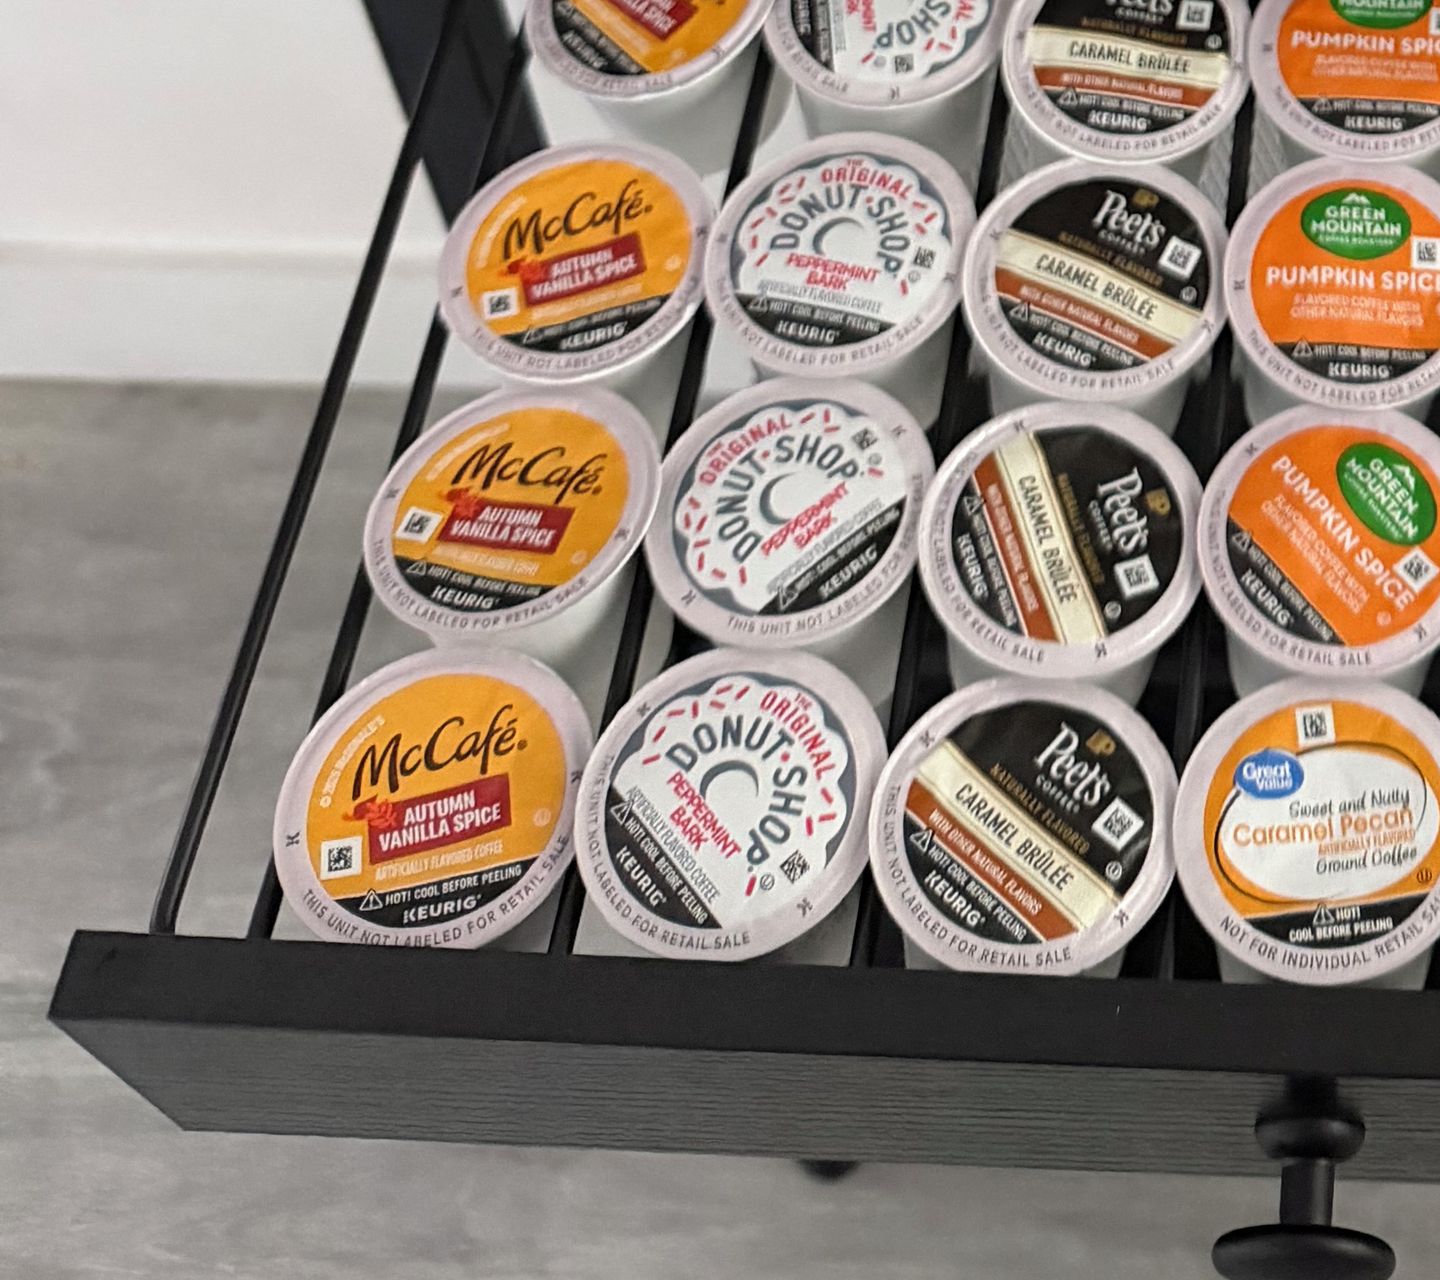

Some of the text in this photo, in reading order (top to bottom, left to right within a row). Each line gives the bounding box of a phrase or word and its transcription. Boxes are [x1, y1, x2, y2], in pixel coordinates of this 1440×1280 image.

[1070, 41, 1132, 66] CARAMEL
[1291, 31, 1395, 54] PUMPKIN
[820, 167, 913, 200] ORIGINAL
[503, 179, 644, 262] McCafé
[769, 184, 911, 274] DONUT SHOP
[1092, 190, 1166, 248] Peet's
[1311, 219, 1401, 236] MOUNTAIN
[1325, 205, 1386, 220] GREEN
[532, 253, 637, 299] VANILLA SPICE
[550, 247, 614, 277] AUTUMN
[786, 253, 881, 282] PEPPERMINT
[806, 270, 849, 290] BARK
[1036, 253, 1101, 292] CARAMEL
[1102, 285, 1158, 321] BRÛLÉE
[1266, 265, 1375, 290] PUMPKIN
[1328, 362, 1391, 378] KEURIG
[451, 442, 608, 505] McCafé
[700, 413, 792, 485] ORIGINAL
[716, 434, 861, 563] DONUT SHOP
[1097, 466, 1149, 555] Peet's
[1346, 457, 1418, 539] MOUNTAIN
[1369, 459, 1419, 514] GREEN
[450, 520, 557, 547] VANILLA SPICE
[478, 506, 543, 527] AUTUMN
[1018, 475, 1079, 604] CARAMEL BRÛLÉE
[1271, 454, 1417, 611] PUMPKIN SPICE
[957, 533, 988, 598] KEURIG
[1240, 569, 1292, 627] KEURIG
[352, 704, 518, 801] McCafé
[760, 690, 836, 780] ORIGINAL
[665, 714, 808, 865] DONUT SHOP
[1033, 721, 1112, 806] Peet's
[1242, 760, 1292, 781] Great
[1256, 774, 1293, 791] Value
[378, 802, 501, 852] VANILLA SPICE
[404, 790, 475, 825] AUTUMN
[666, 771, 743, 859] PEPPERMINT
[669, 806, 708, 853] BARK
[1233, 806, 1413, 848] Caramel Pecan
[1289, 789, 1410, 819] Sweet and Nutty
[955, 783, 1074, 892] CARAMEL BRÛLÉE
[1316, 844, 1417, 875] Ground Coffee
[303, 835, 568, 948] THIS UNIT NOT LABELED FOR RETAIL SALE
[385, 865, 522, 906] HOT! COOL BEFORE PEELING
[615, 844, 667, 907] KEURIG
[625, 816, 708, 924] HOT! COOL BEFORE PEELING
[403, 894, 480, 924] KEURIG
[924, 869, 982, 928] KEURIG
[966, 880, 1028, 942] BEFORE PEELING
[1289, 906, 1360, 942] HOT! COOL
[631, 915, 750, 950] FOR RETAIL SALE
[900, 890, 1072, 967] LABELED FOR RETAIL SALE
[1220, 915, 1249, 944] NOT
[1249, 938, 1277, 960] FOR
[1282, 949, 1370, 970] INDIVIDUAL
[1375, 922, 1424, 958] RETAIL
[1316, 917, 1393, 940] BEFORE PEELING
